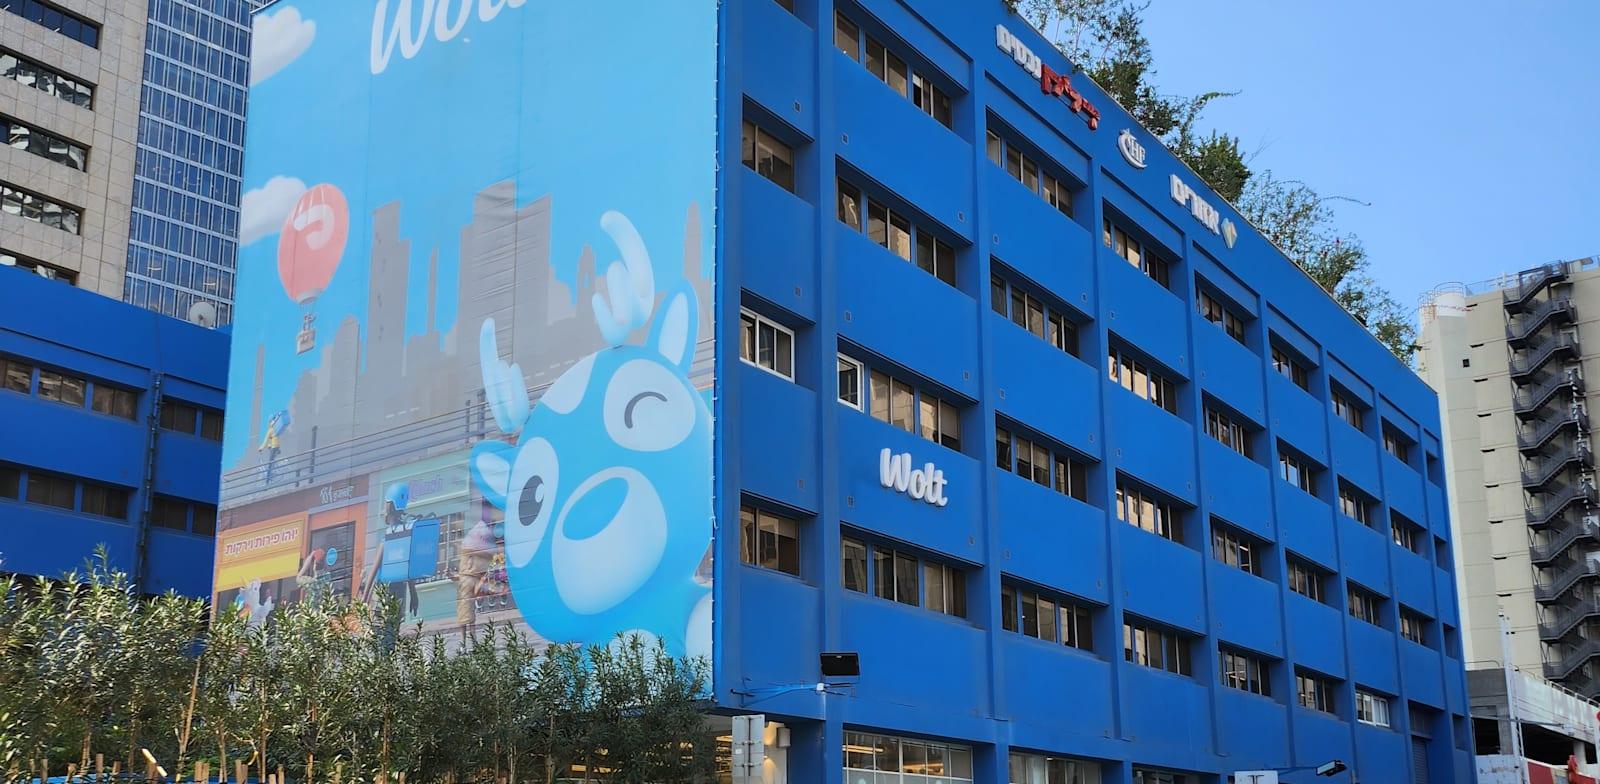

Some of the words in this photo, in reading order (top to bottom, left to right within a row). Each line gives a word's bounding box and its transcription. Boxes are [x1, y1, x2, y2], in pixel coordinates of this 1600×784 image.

[370, 0, 528, 75] Wo
[996, 23, 1042, 79] נכסים
[1169, 173, 1220, 236] אזורים
[879, 447, 949, 507] Wolt
[225, 539, 254, 555] וירקות
[255, 532, 281, 549] פירות
